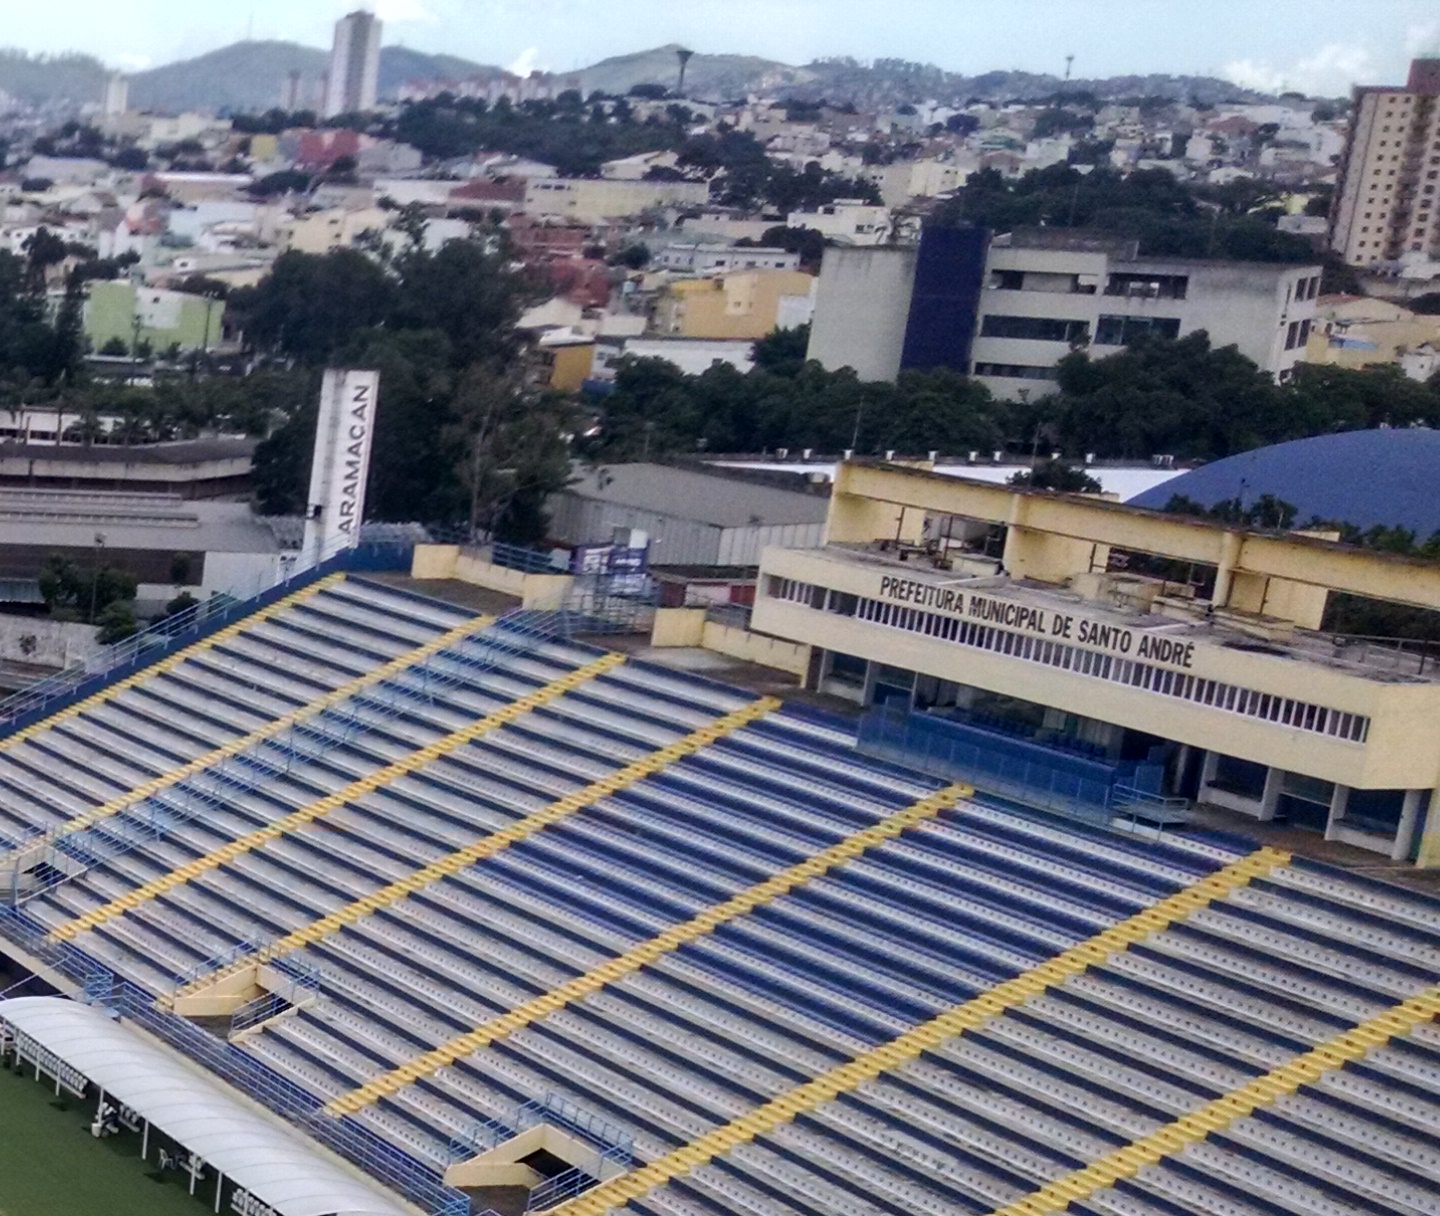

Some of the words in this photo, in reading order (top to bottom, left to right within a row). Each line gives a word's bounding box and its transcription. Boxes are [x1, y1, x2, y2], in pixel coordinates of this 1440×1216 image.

[338, 385, 370, 535] ARAMACAN
[879, 576, 964, 613] PREFEITURA
[969, 596, 1045, 633] MUNICIPAL
[1051, 614, 1074, 639] DE
[1077, 620, 1132, 653] SANTO
[1137, 635, 1195, 668] ANDRÉ
